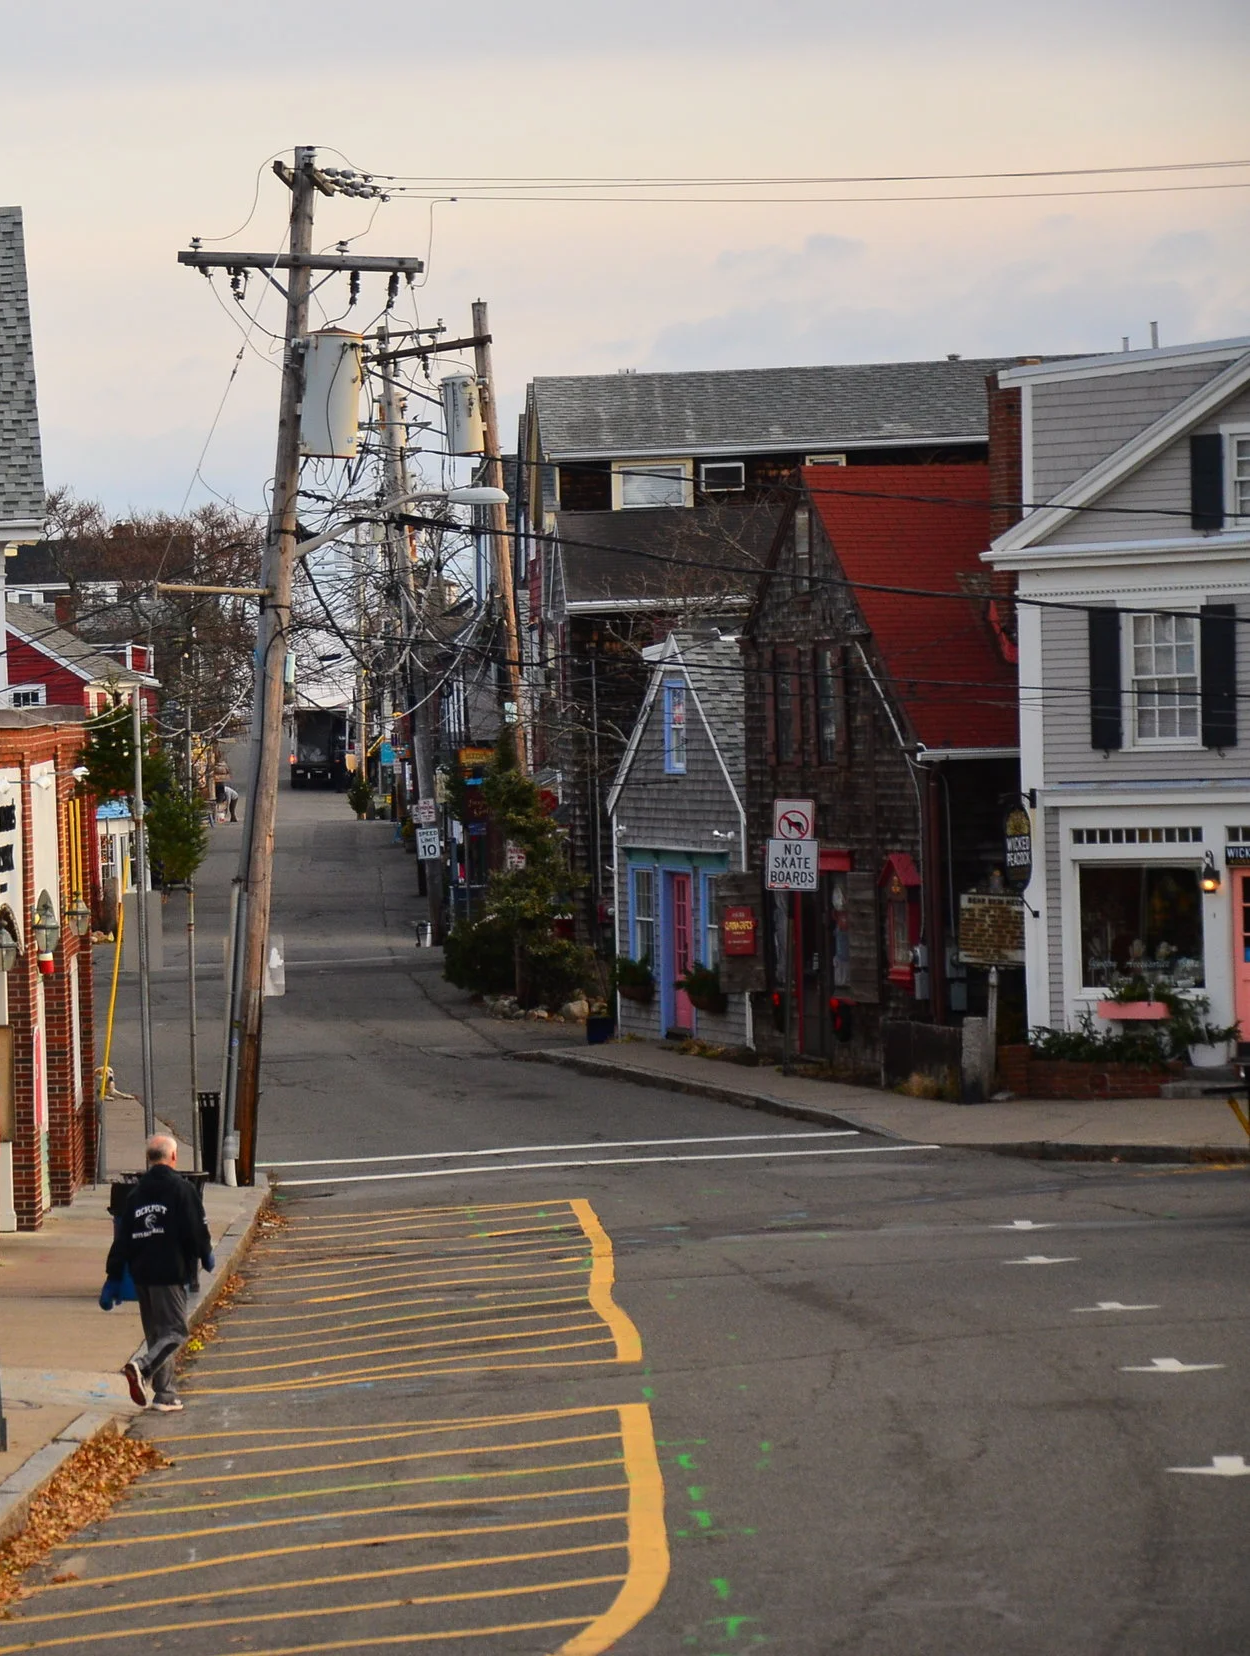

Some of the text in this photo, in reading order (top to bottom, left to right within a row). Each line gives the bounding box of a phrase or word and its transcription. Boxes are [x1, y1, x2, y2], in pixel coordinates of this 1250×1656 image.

[784, 844, 802, 856] NO
[1006, 836, 1031, 852] WICKED
[422, 844, 437, 857] 10
[774, 857, 811, 869] SKATE
[1006, 851, 1032, 868] PEACOCK
[770, 871, 815, 883] BOARDS
